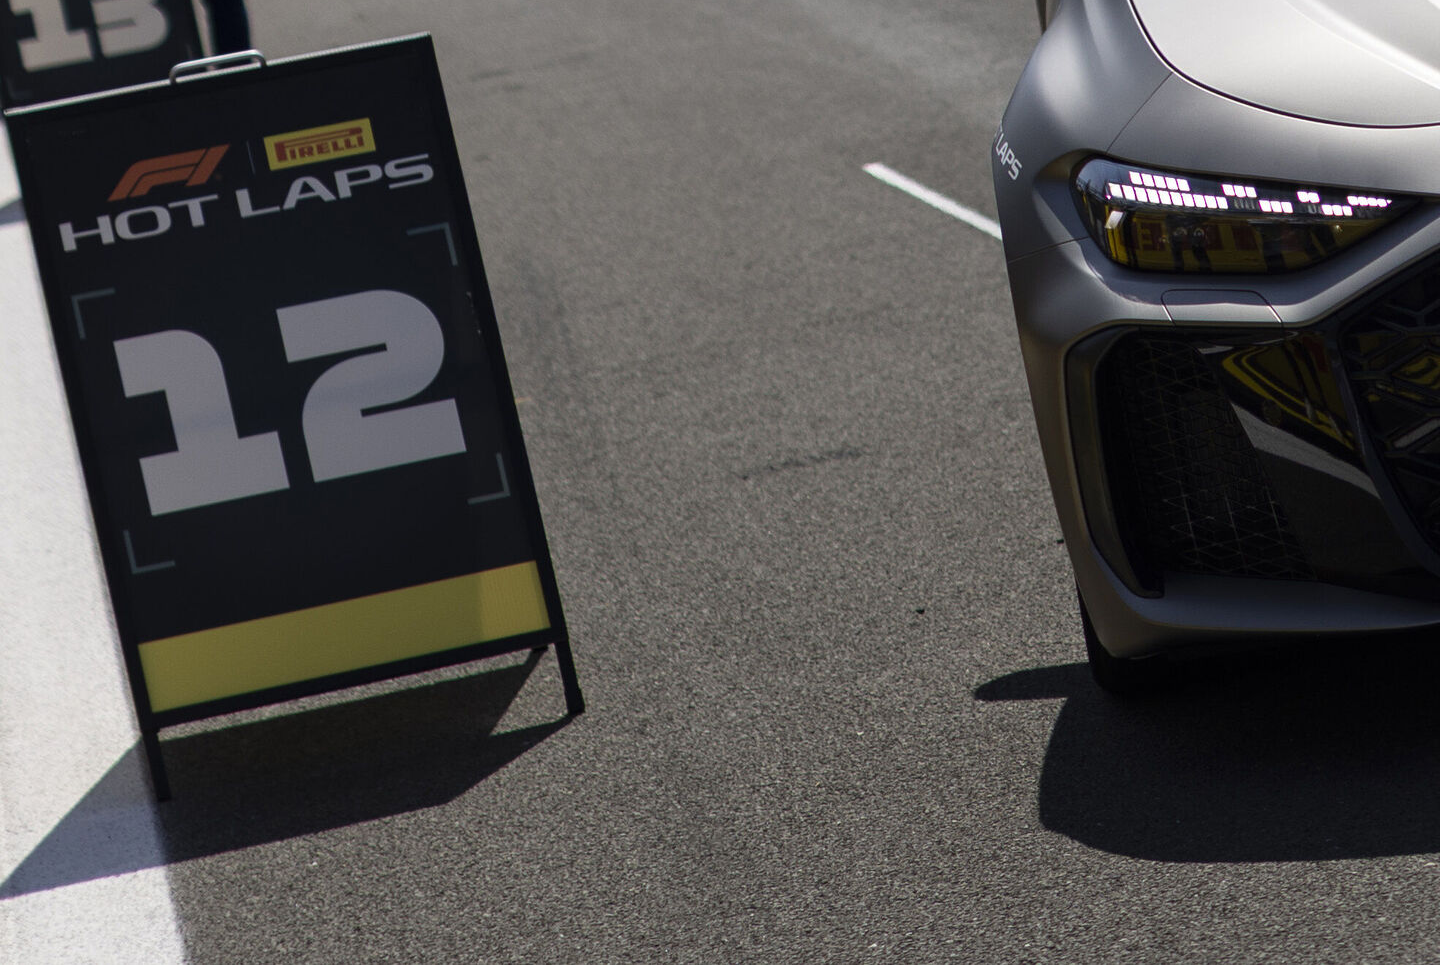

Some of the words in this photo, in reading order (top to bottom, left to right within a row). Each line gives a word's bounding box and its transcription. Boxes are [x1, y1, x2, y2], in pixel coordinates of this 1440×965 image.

[274, 126, 365, 162] PIRELLI
[995, 132, 1023, 181] LAPS
[58, 193, 219, 252] HOT
[236, 154, 434, 219] LAPS
[113, 289, 467, 517] 12
